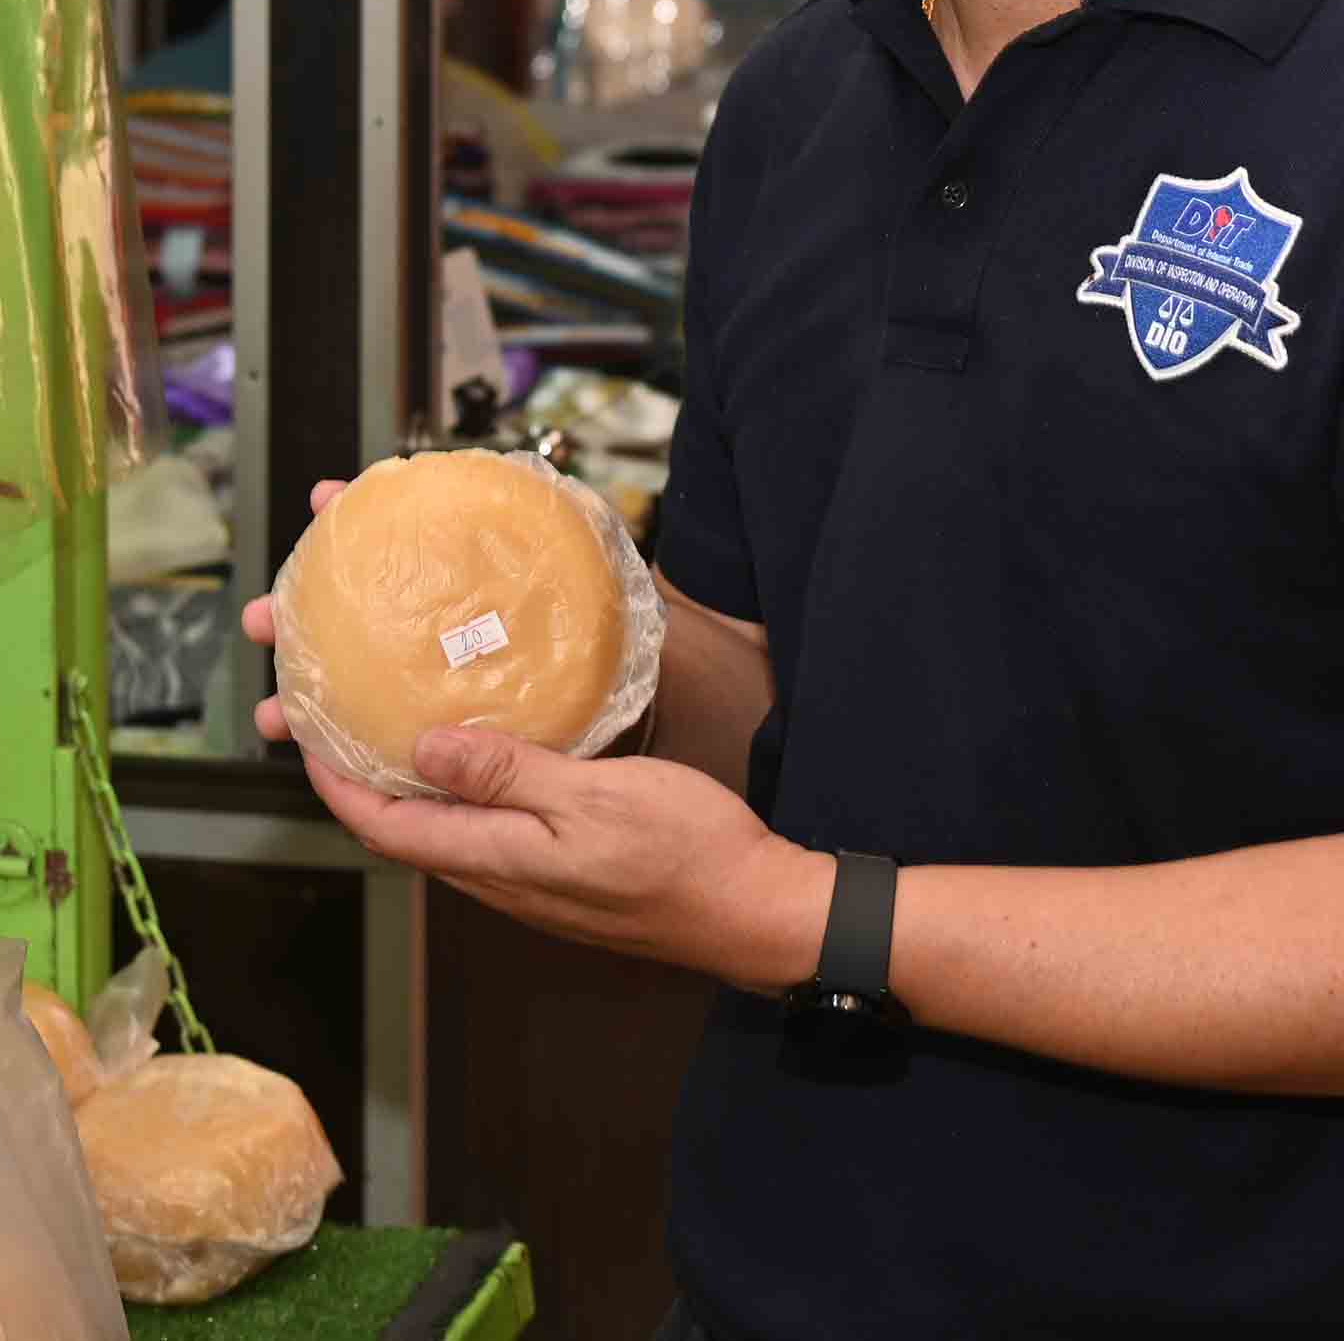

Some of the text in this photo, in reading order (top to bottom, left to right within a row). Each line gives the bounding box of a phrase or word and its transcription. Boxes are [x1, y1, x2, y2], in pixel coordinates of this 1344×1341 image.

[1151, 229, 1197, 253] Department
[1123, 254, 1258, 313] DIVISION OF INSPECTION AND OPERATION
[460, 628, 484, 652] 20
